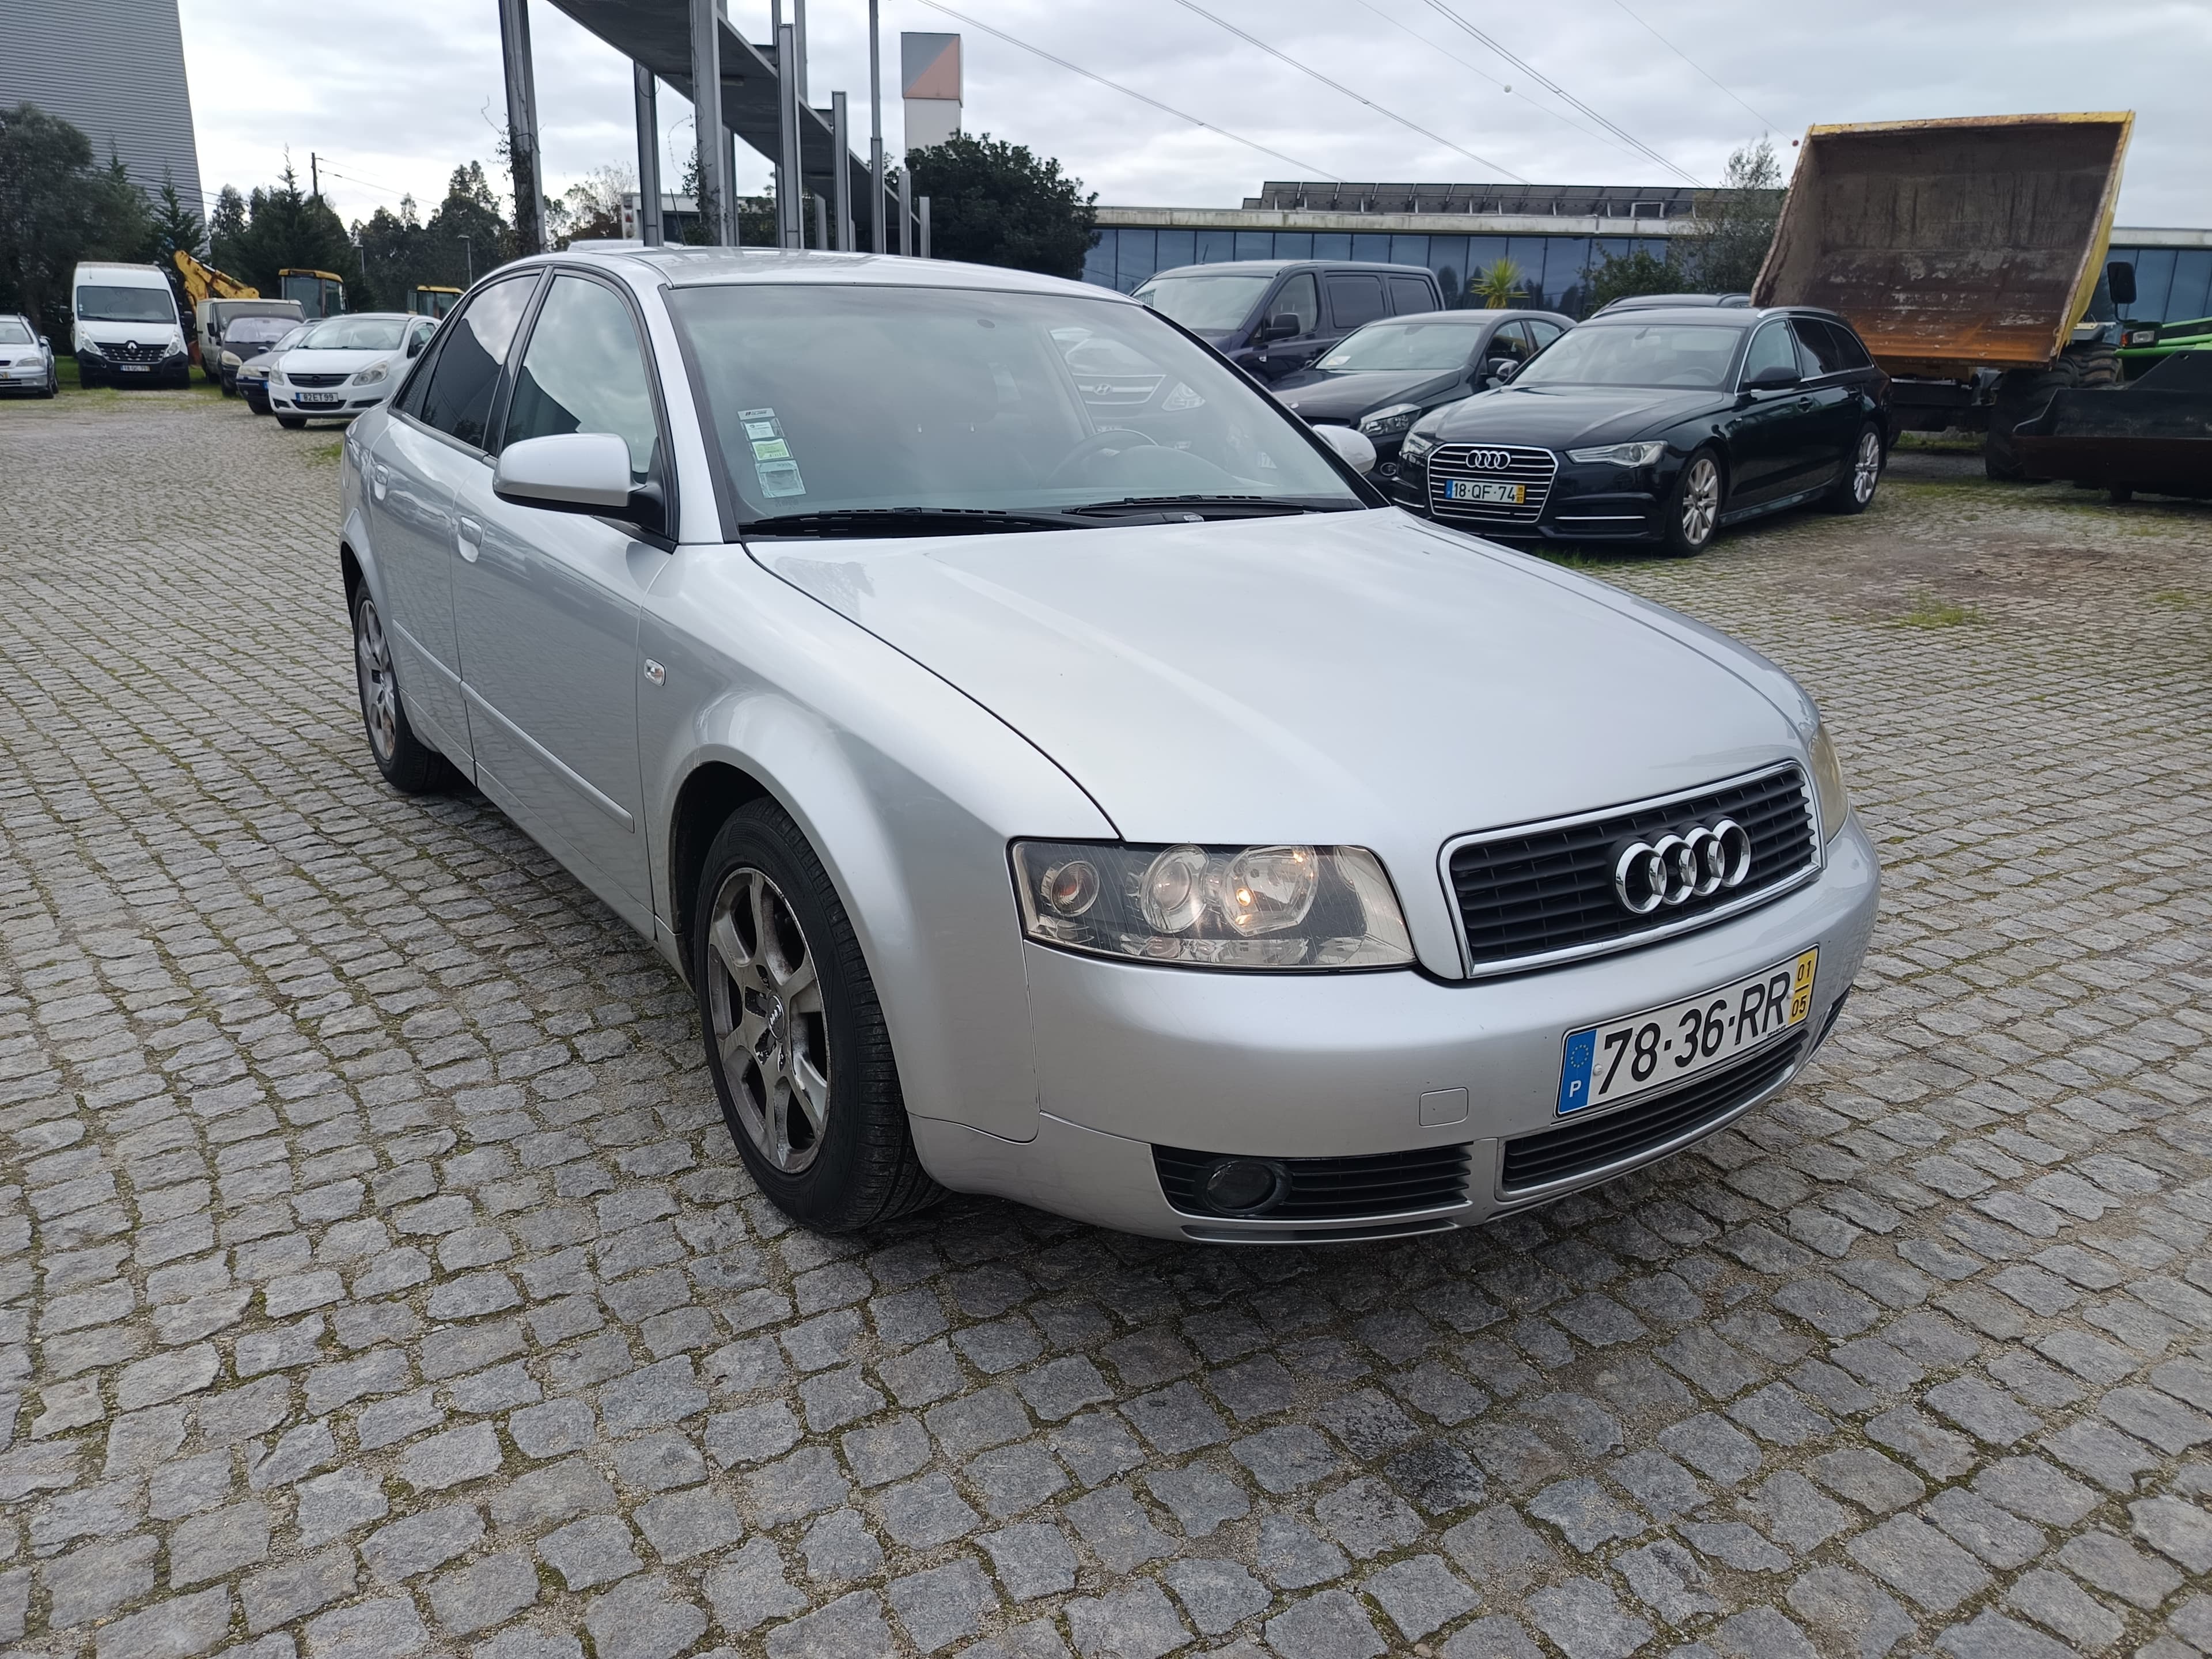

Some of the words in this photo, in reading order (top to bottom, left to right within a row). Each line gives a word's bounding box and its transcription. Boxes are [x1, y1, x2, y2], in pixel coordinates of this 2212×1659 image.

[1797, 959, 1812, 982] 01
[1791, 995, 1806, 1017] 05
[1569, 1080, 1582, 1098] P
